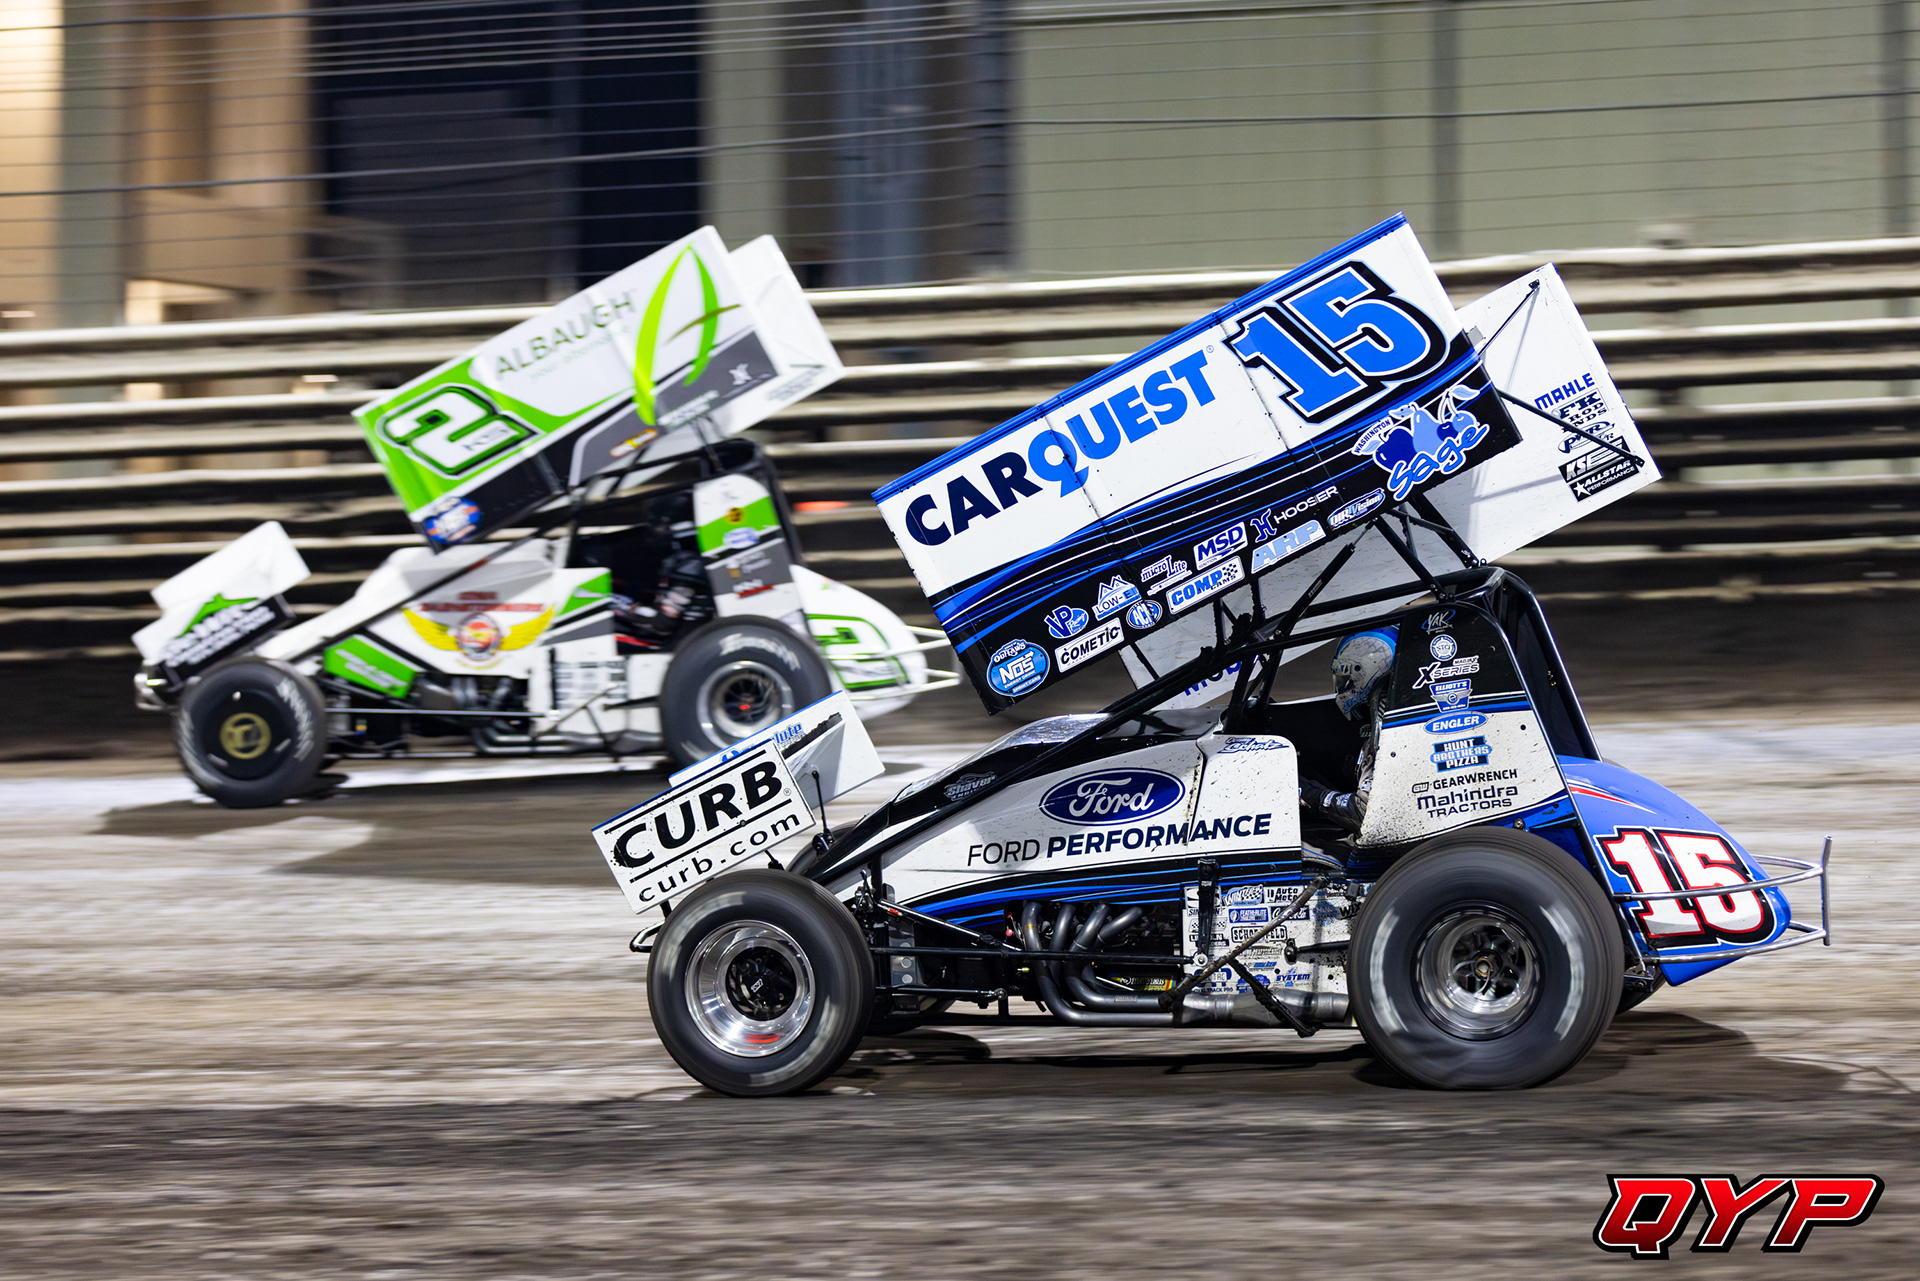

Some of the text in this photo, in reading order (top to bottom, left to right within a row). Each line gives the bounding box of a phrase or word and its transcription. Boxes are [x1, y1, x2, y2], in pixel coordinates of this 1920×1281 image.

[496, 291, 636, 380] ALBAUGH
[1229, 264, 1440, 420] 15
[1534, 372, 1595, 410] MAHLE
[1560, 391, 1601, 419] FK
[1568, 402, 1604, 422] ROD
[906, 350, 1216, 546] CARQUEST
[1354, 418, 1391, 453] WASHINGTON
[1584, 460, 1632, 487] ALLSTAR
[1587, 466, 1636, 493] PERFORMANCE
[1198, 525, 1244, 562] MSD
[1253, 522, 1319, 569] ARP
[1171, 569, 1223, 606] COMP
[1210, 574, 1237, 590] CAMS
[1045, 606, 1073, 637] VP
[1061, 626, 1121, 665] COMETIC
[999, 651, 1034, 684] NOS
[1432, 715, 1480, 732] ENGLER
[1432, 746, 1490, 763] BROTHERS
[1443, 738, 1475, 752] HUNT
[1445, 755, 1479, 769] PIZZA
[1433, 768, 1517, 790] GEARWRENCH
[1068, 777, 1154, 817] Ford
[1417, 785, 1518, 810] Mahindra
[1427, 798, 1512, 818] TRACTORS
[613, 760, 783, 868] CURB
[967, 813, 1272, 867] FORD PERFORMANCE
[638, 813, 801, 903] curb.com
[1276, 887, 1299, 896] Auto
[1600, 828, 1770, 943] 15
[1276, 973, 1311, 982] SYSTEM
